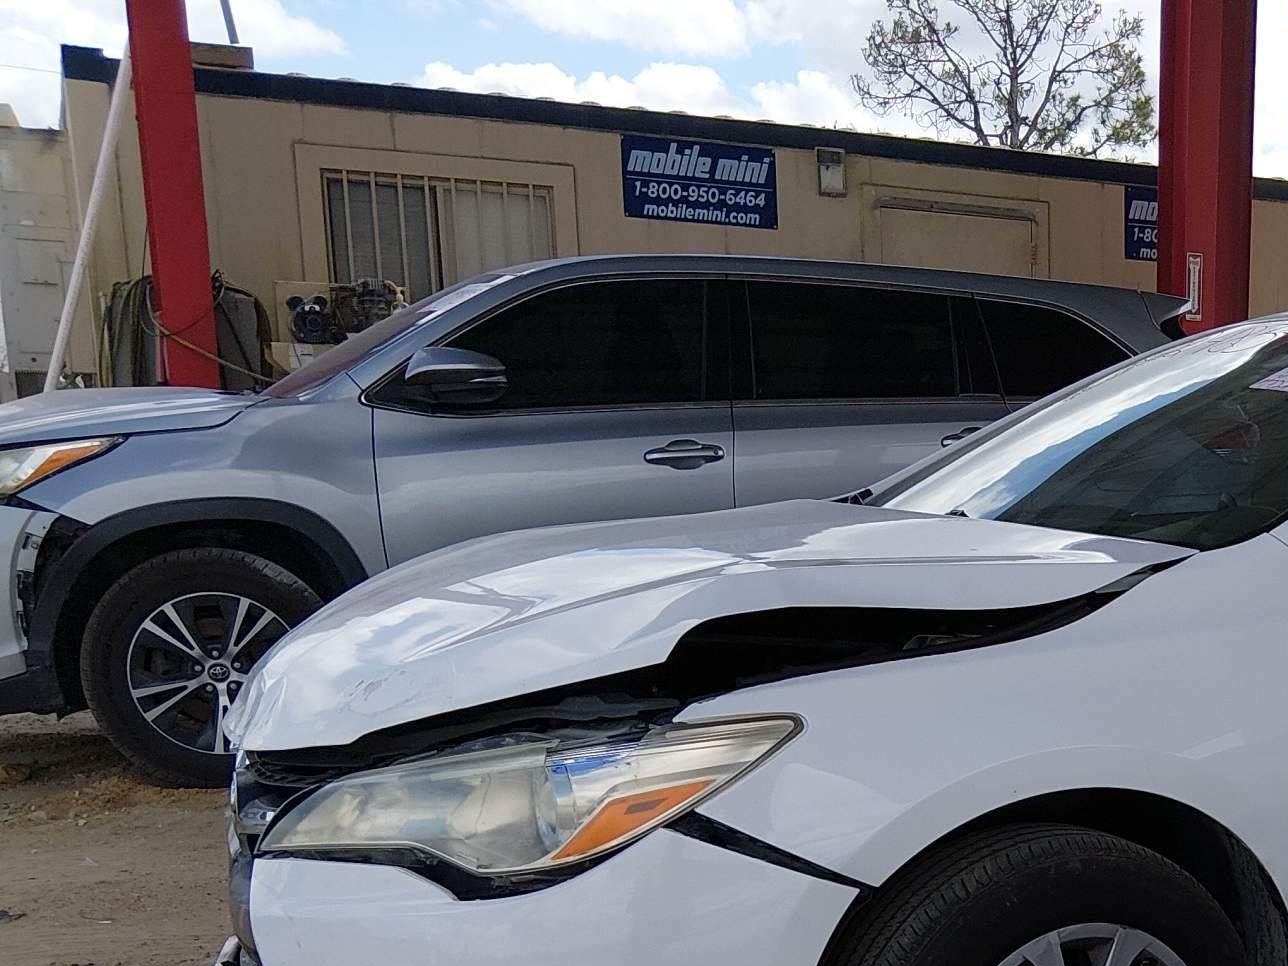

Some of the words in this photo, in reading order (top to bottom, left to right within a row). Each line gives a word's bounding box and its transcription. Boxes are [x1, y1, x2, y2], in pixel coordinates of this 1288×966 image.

[627, 143, 712, 178] mobile
[715, 155, 770, 184] mini
[634, 180, 766, 208] 1-800-950-6464
[643, 203, 760, 225] mobilemini.com
